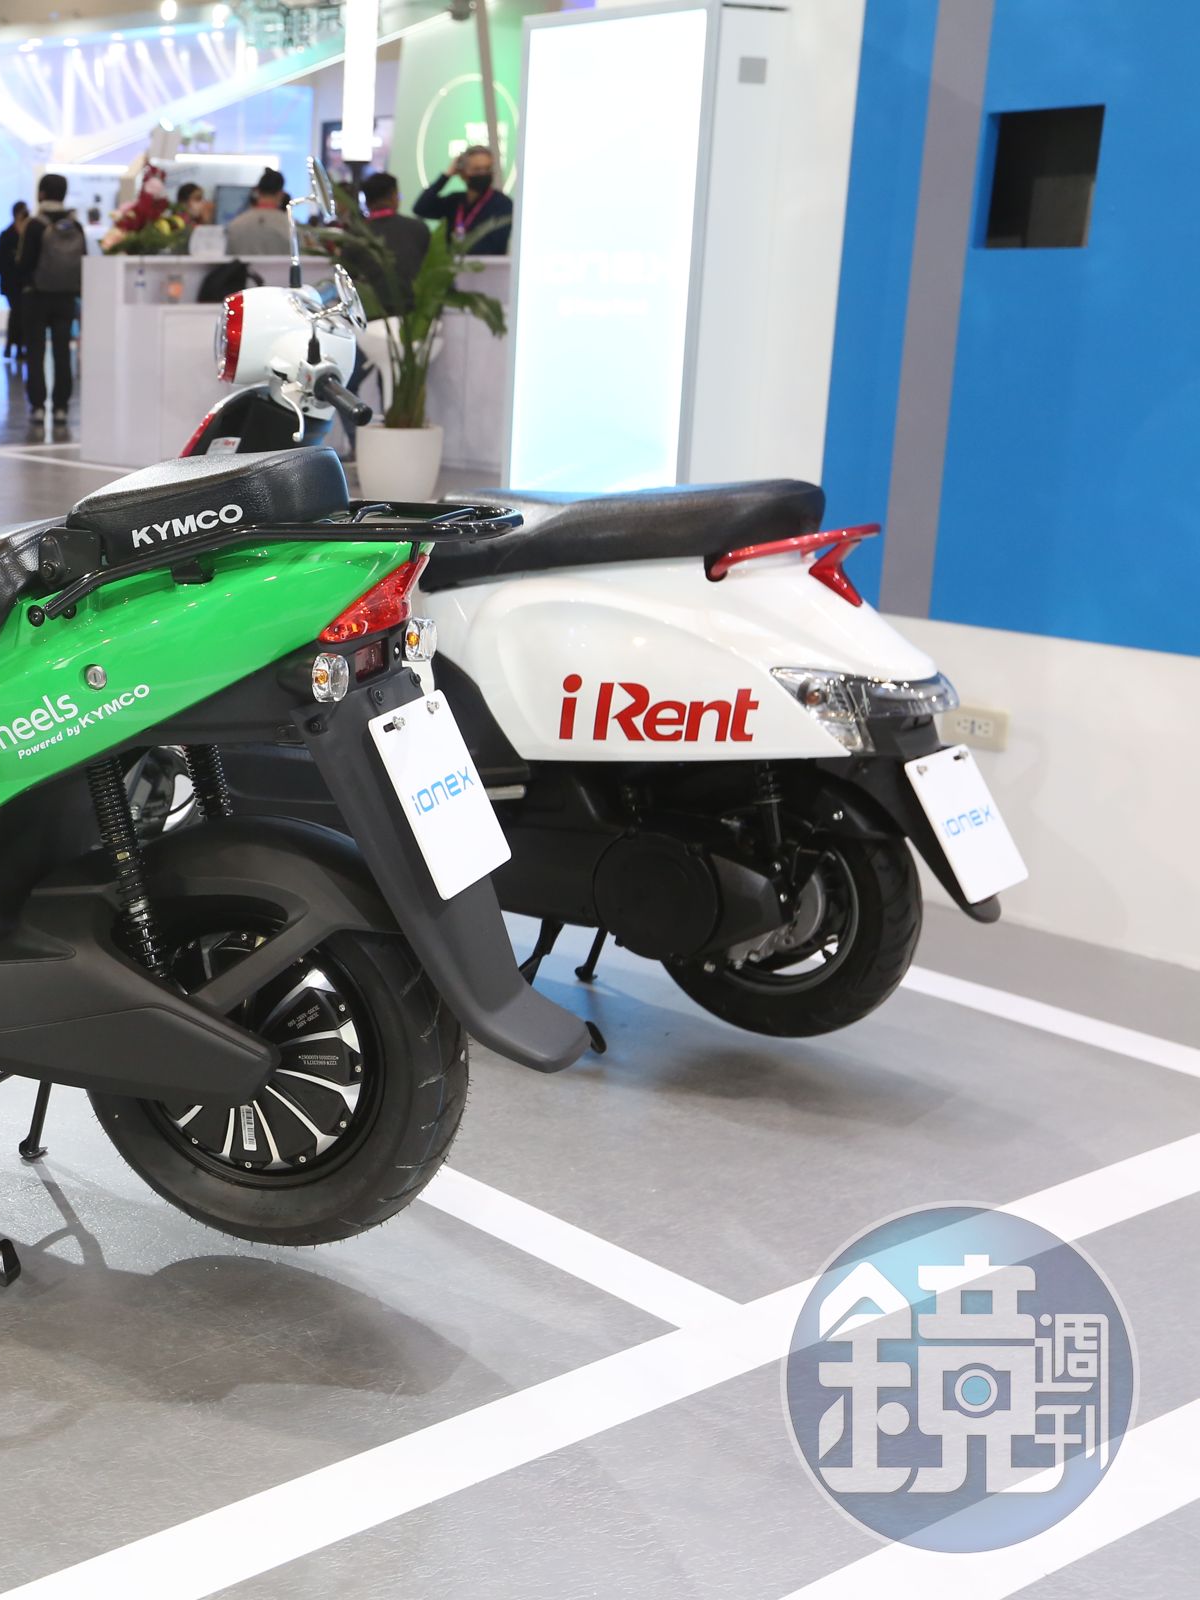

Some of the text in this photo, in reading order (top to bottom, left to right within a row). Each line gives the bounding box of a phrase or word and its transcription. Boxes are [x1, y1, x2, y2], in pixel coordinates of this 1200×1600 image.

[131, 504, 244, 549] KYMCO
[17, 684, 150, 760] Powered by KYMCO
